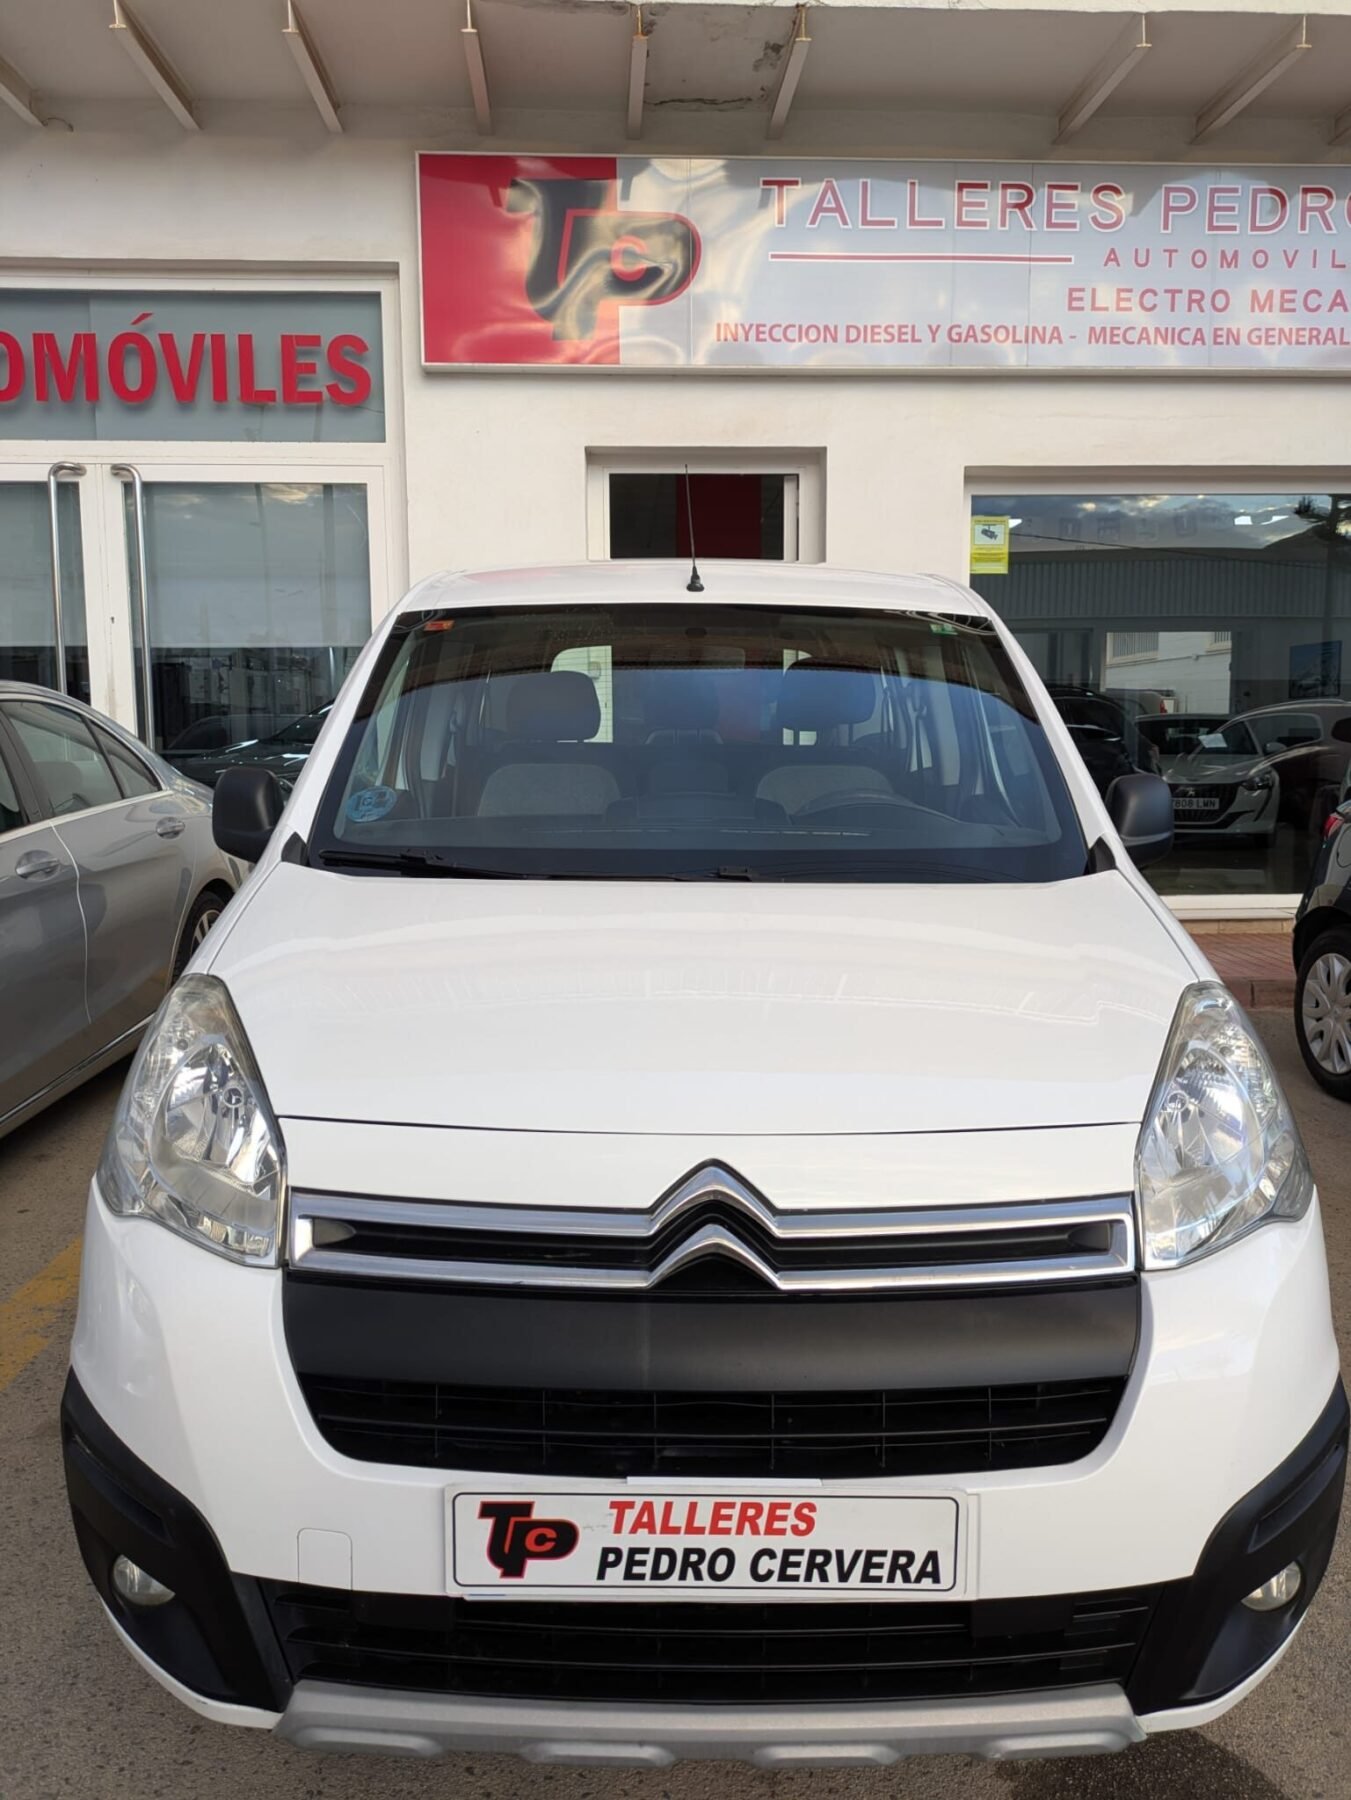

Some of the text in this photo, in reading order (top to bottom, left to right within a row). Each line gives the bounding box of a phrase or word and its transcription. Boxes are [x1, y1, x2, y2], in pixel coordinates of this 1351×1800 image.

[759, 178, 1351, 235] TALLERES PEDR
[1103, 248, 1346, 269] AUTOMOVIL
[1067, 287, 1349, 313] ELECTRO MECA
[716, 323, 838, 343] INYECCION
[845, 324, 922, 344] DIESEL
[928, 324, 942, 344] Y
[947, 324, 1063, 345] GASOLINA
[1088, 326, 1206, 345] MECANICA
[1212, 327, 1241, 345] EN
[1247, 327, 1351, 346] GENERAL
[609, 1501, 818, 1537] TALLERES
[596, 1547, 942, 1585] PEDRO CERVERA
